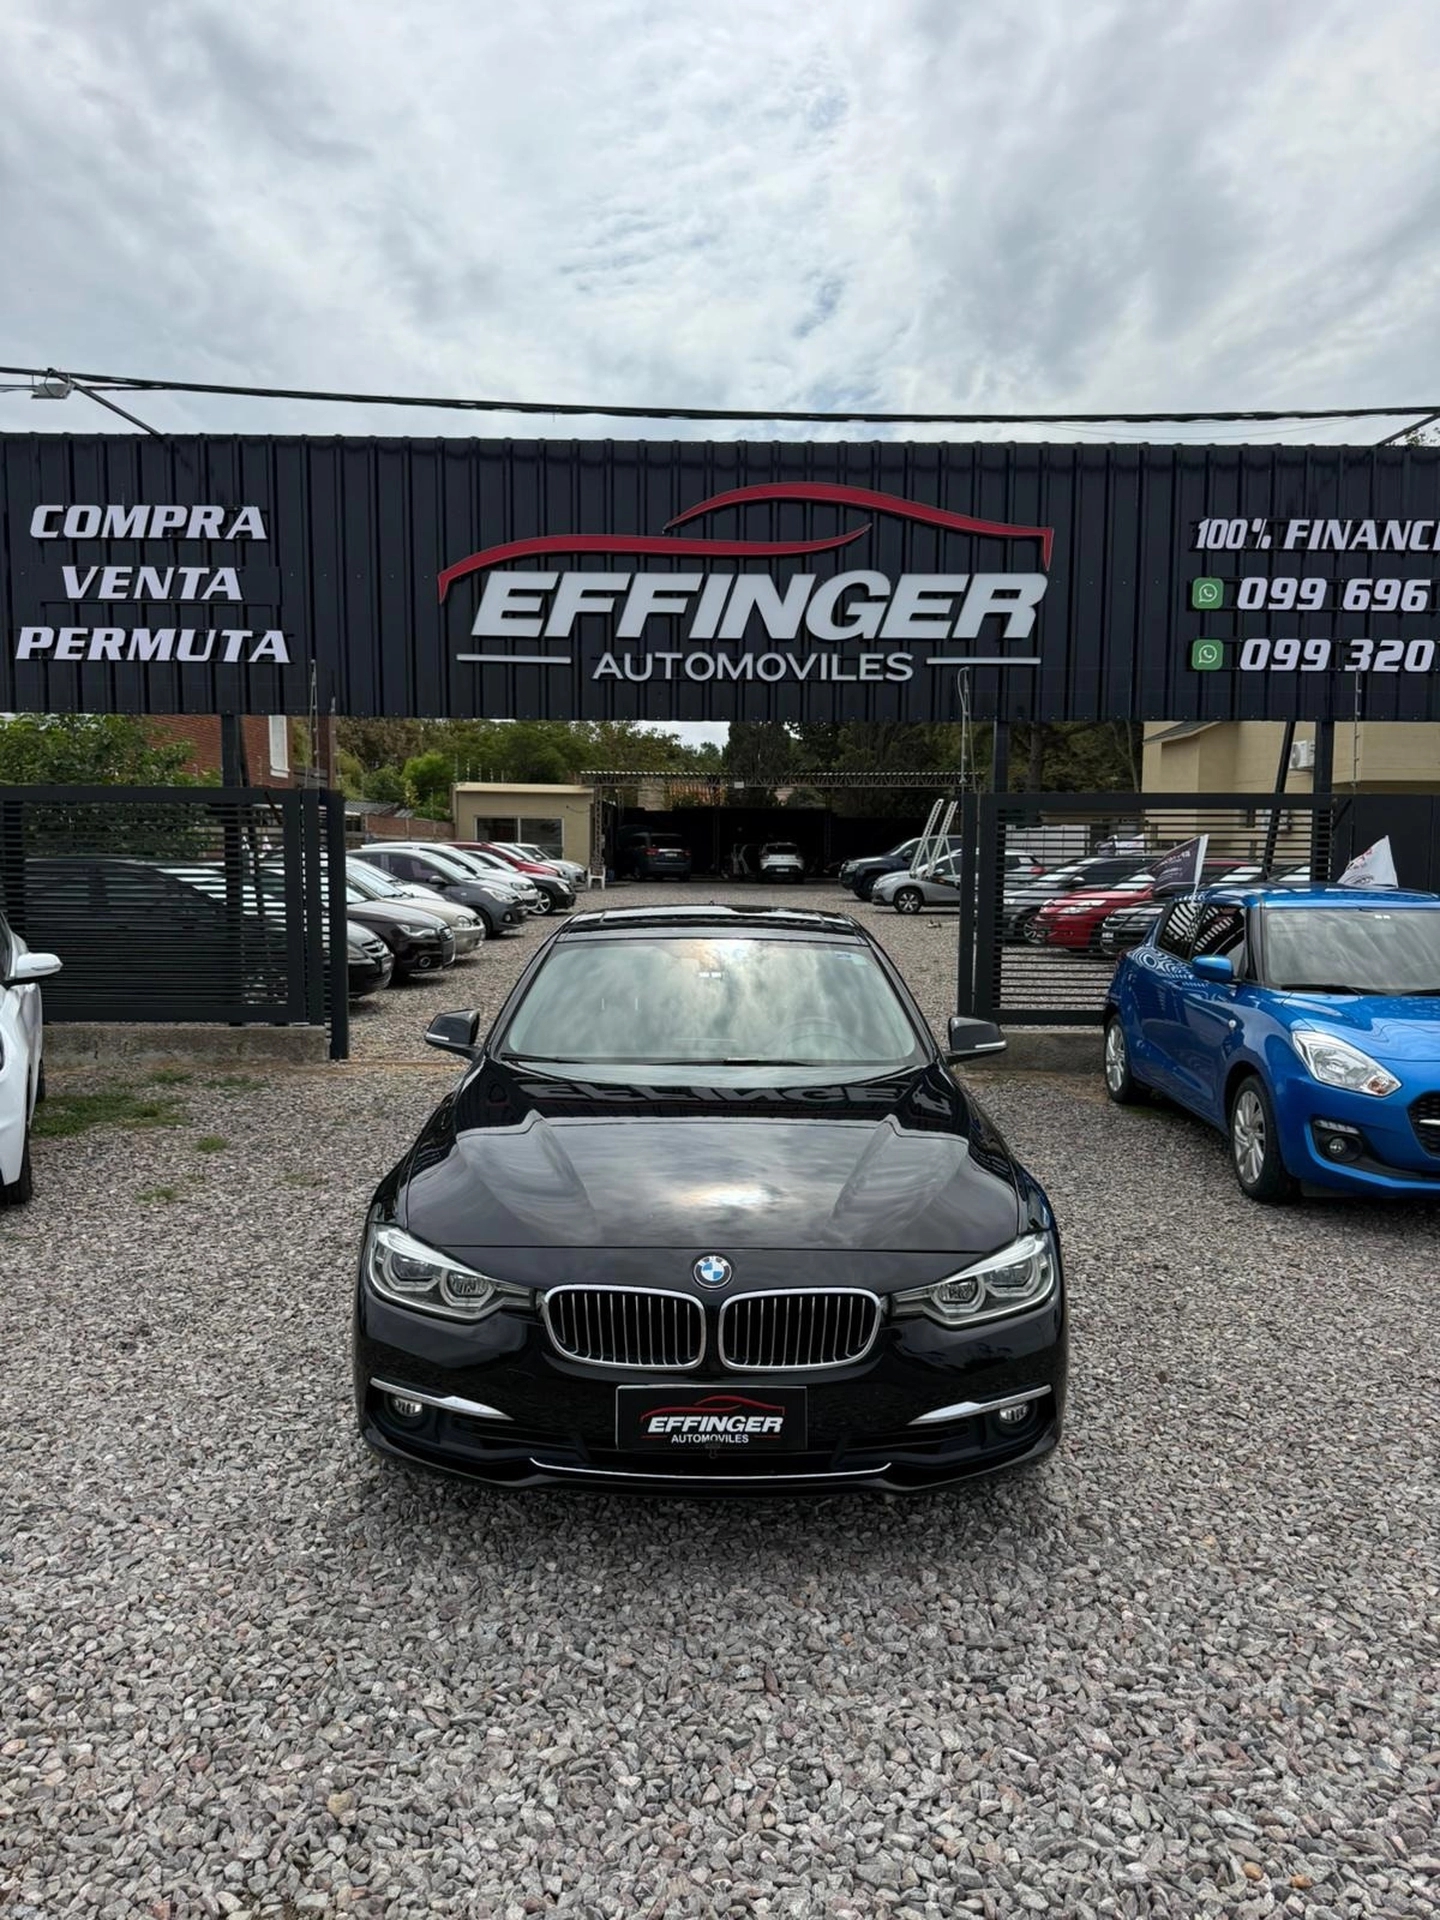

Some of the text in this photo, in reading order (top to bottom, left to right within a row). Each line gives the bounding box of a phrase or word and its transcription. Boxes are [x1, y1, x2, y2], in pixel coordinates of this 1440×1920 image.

[30, 505, 267, 540] COMPRA
[1195, 518, 1272, 550] 100%
[62, 566, 243, 601] VENTA
[1237, 577, 1431, 612] 099 696
[471, 570, 1048, 640] EFFINGER
[15, 626, 290, 663] PERMUTA
[1239, 639, 1435, 672] 099 320
[592, 652, 914, 682] AUTOMOVILES
[647, 1416, 784, 1433] EFFINGER
[671, 1433, 749, 1443] AUTOMOVILES
